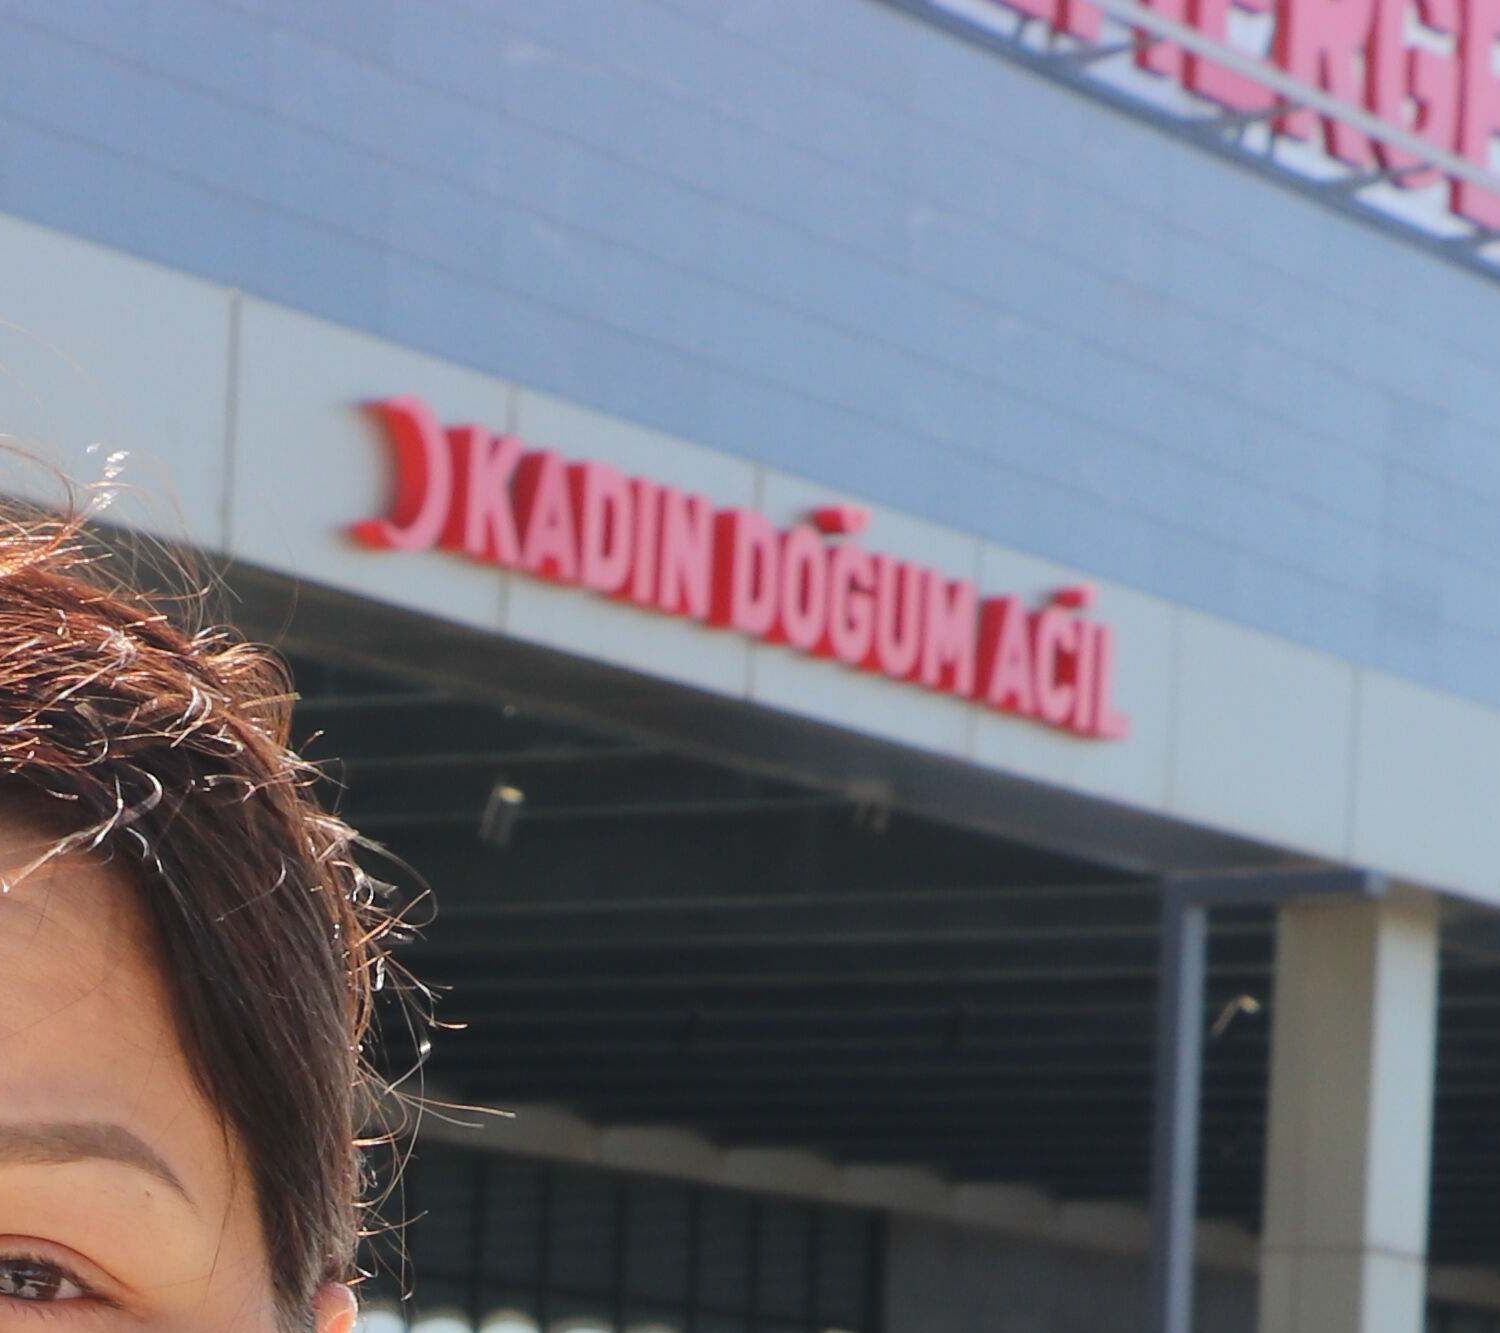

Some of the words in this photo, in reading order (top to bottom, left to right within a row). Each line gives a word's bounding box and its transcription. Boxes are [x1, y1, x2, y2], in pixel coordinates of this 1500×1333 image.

[444, 422, 713, 622] KADIN
[718, 504, 976, 700] DOĞUM
[982, 582, 1131, 740] ACİL
